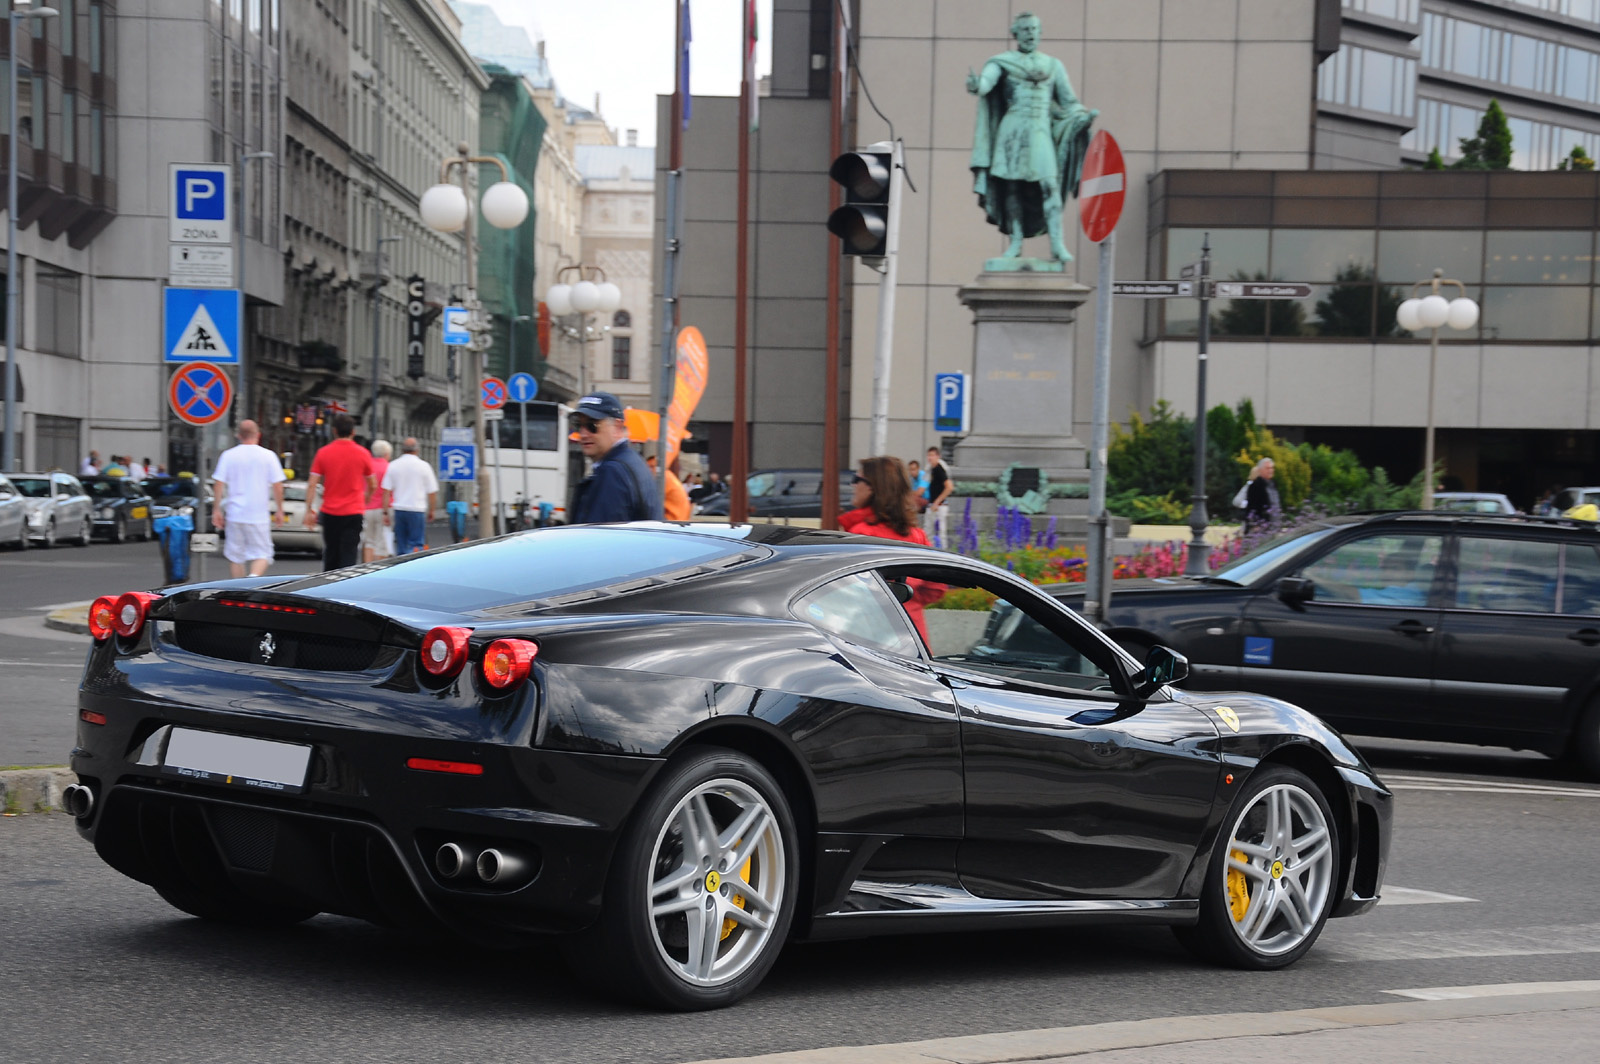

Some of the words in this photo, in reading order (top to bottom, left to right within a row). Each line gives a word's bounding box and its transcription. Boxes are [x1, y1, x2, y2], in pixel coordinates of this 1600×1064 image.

[185, 178, 216, 212] P
[941, 381, 959, 416] P
[447, 455, 466, 476] P
